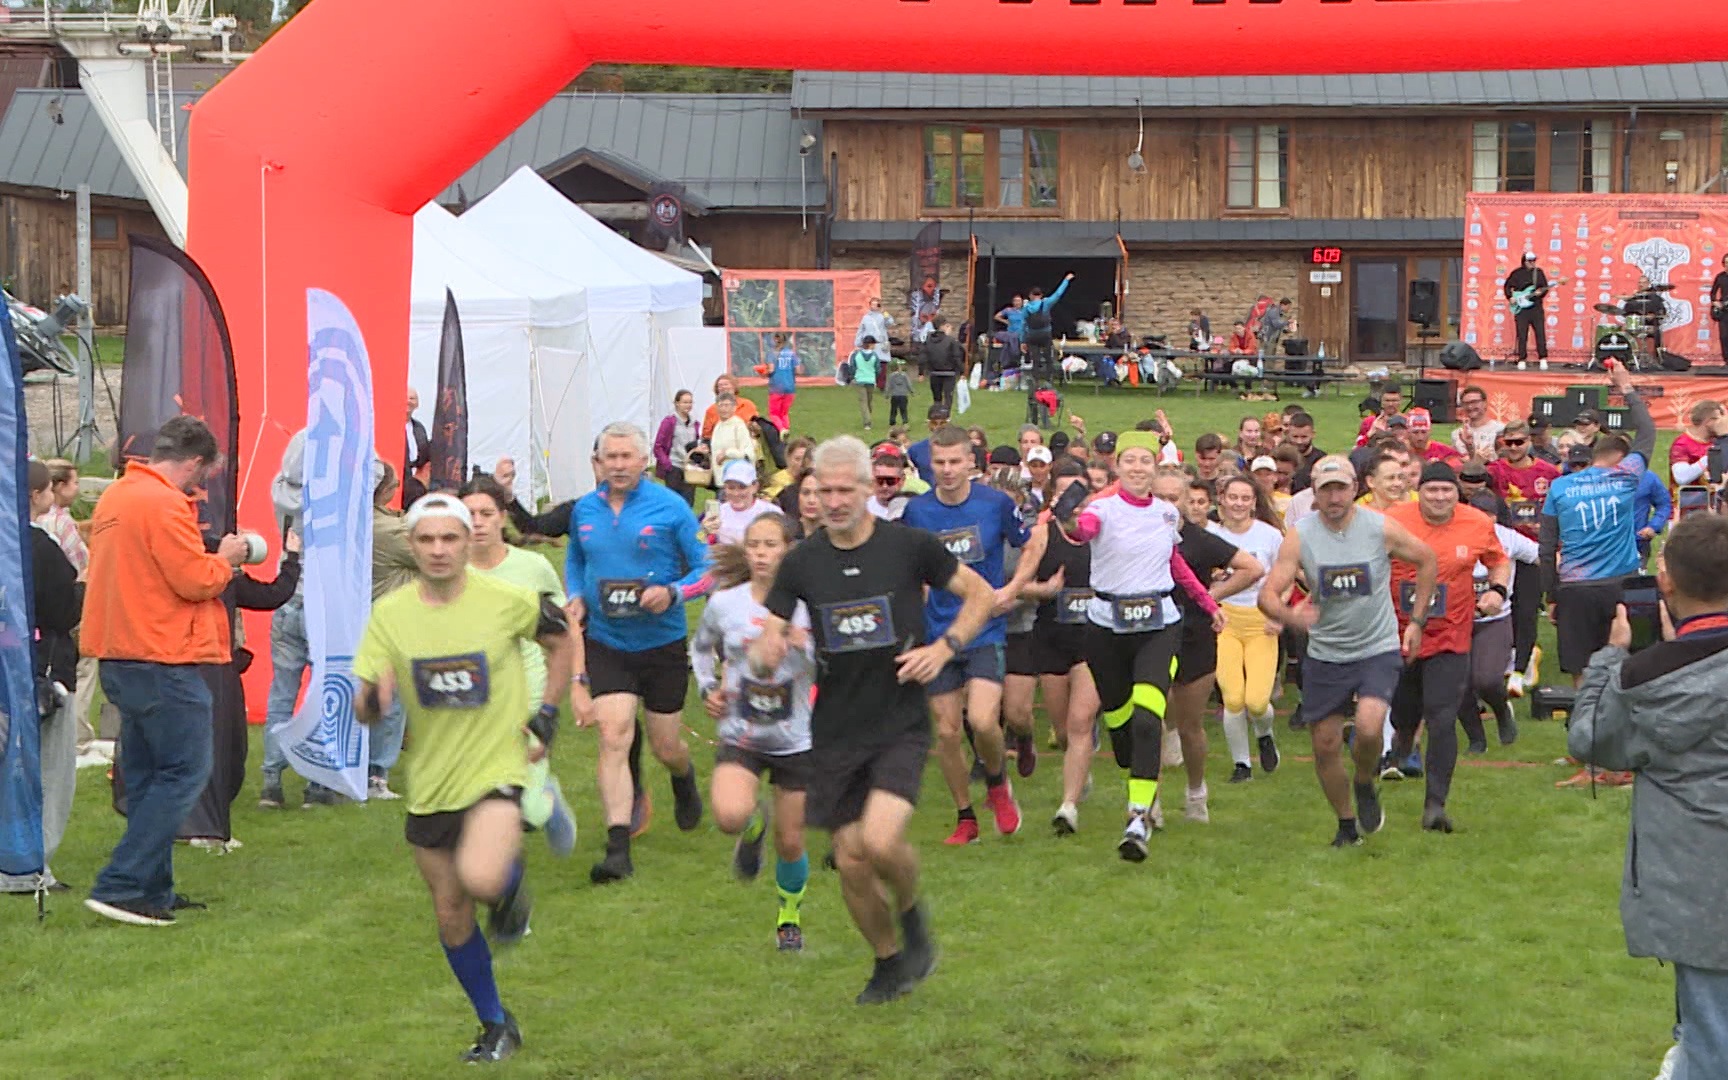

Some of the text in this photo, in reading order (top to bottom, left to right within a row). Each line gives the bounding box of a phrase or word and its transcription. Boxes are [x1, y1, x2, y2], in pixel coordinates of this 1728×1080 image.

[1543, 401, 1553, 416] II
[1608, 413, 1622, 427] III
[1332, 575, 1357, 589] 411
[608, 589, 637, 604] 474
[1124, 604, 1153, 621] 509
[838, 613, 878, 635] 495
[428, 670, 473, 693] 453
